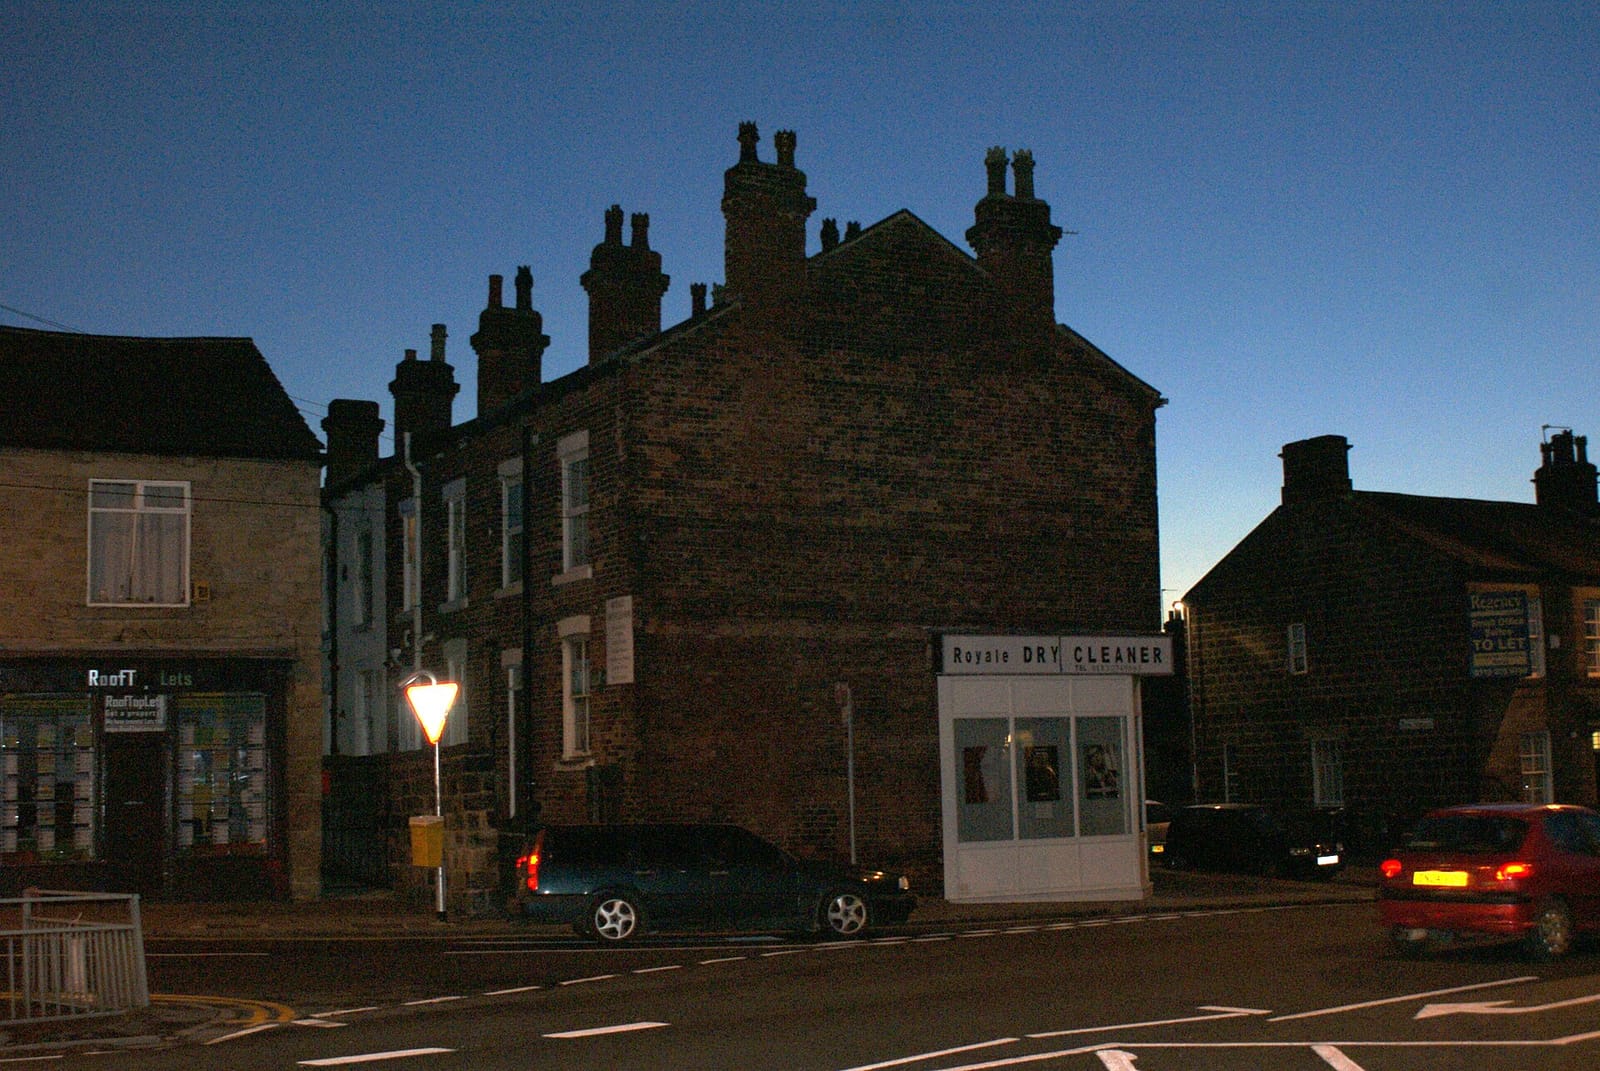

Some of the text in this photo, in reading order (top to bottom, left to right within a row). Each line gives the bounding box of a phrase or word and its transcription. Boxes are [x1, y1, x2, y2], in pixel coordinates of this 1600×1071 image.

[1472, 637, 1526, 651] TO LET
[953, 645, 1163, 664] Royale DRY CLEANER
[160, 669, 192, 686] Lets
